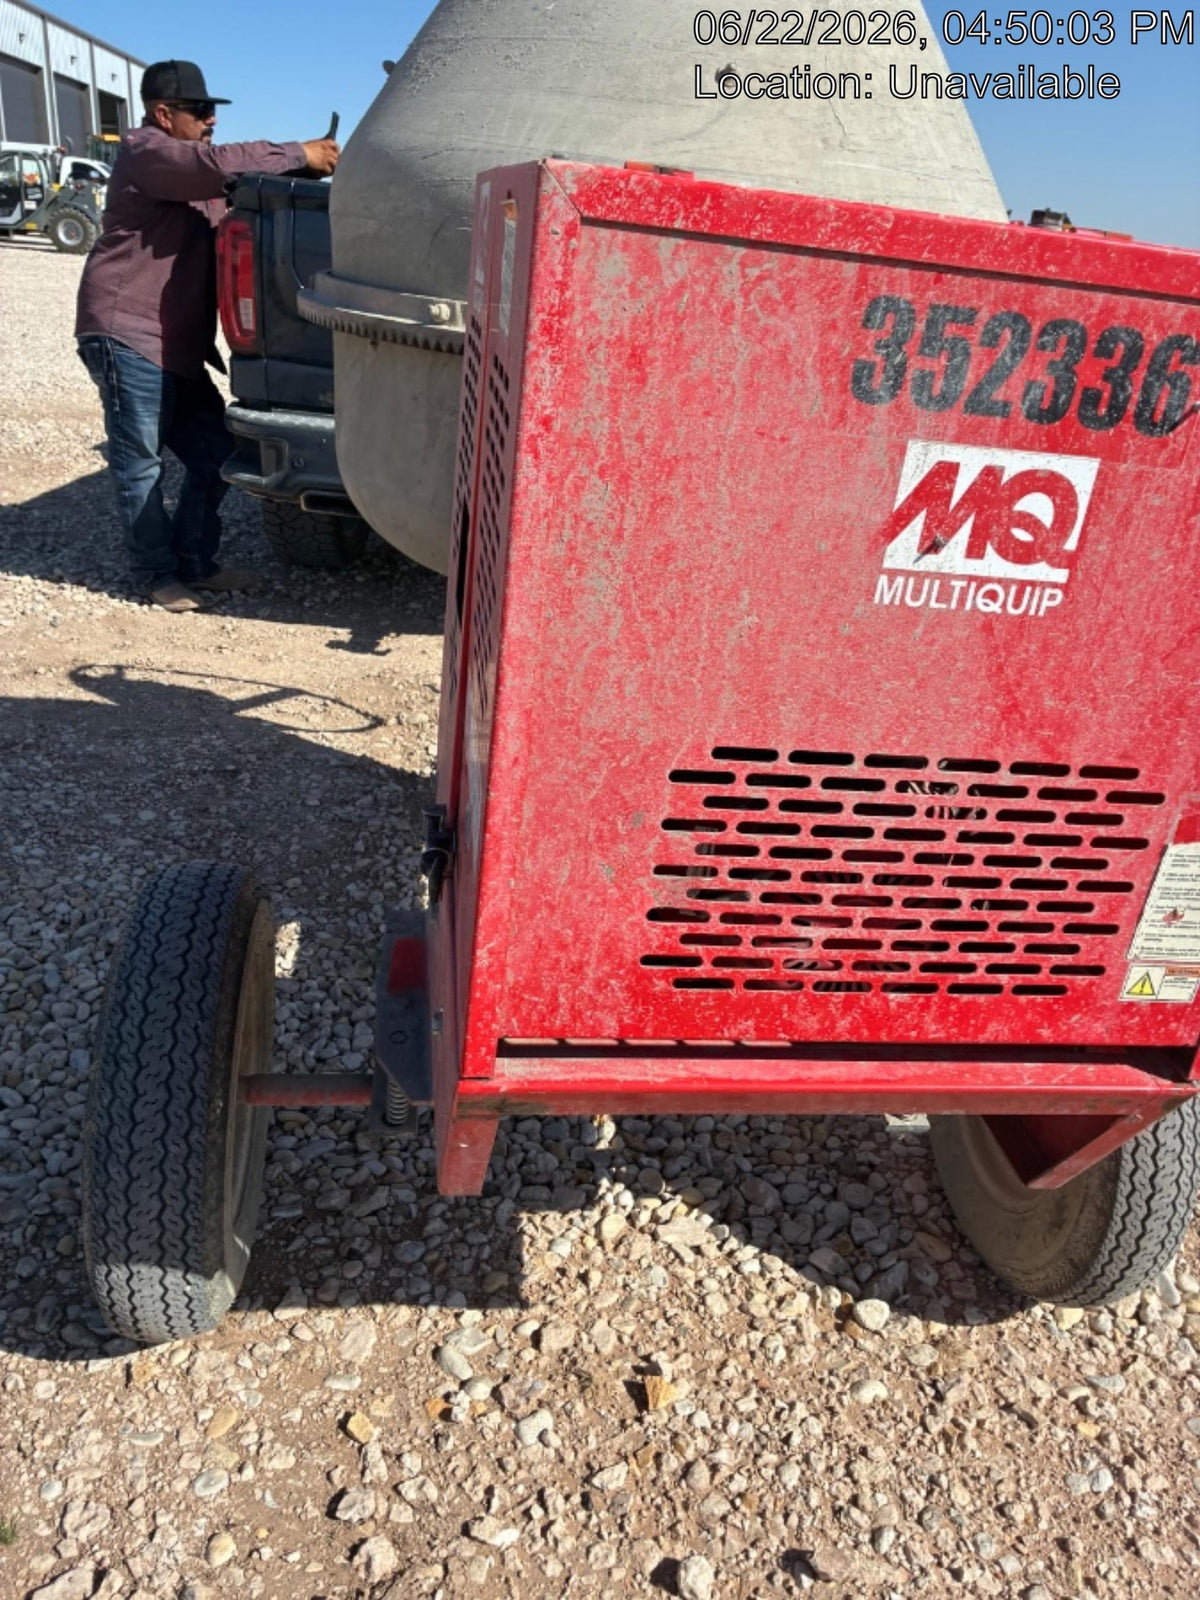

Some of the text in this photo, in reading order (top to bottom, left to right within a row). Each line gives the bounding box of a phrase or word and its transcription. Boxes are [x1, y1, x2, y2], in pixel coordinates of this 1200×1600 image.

[850, 294, 1200, 438] 352336
[880, 459, 1080, 570] MQ
[873, 574, 1064, 617] MULTIQUIP
